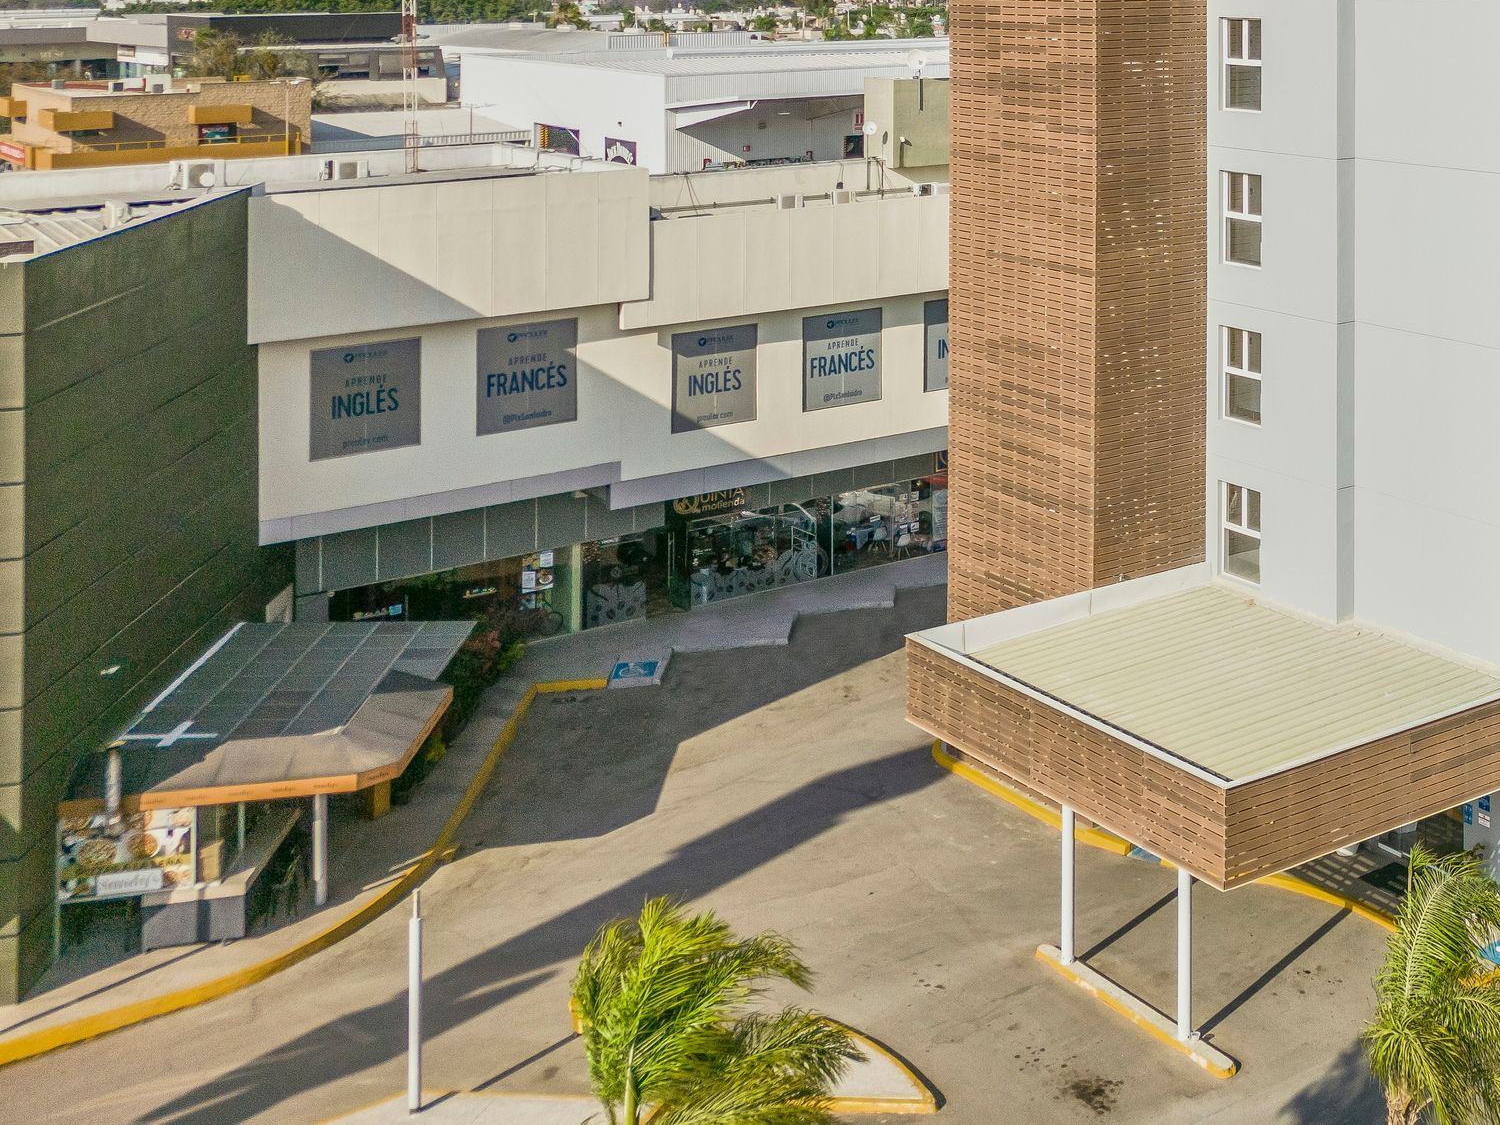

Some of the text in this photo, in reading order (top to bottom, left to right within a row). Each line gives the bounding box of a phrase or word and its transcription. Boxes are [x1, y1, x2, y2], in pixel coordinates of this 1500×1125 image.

[827, 338, 859, 350] APRENDE
[507, 353, 547, 366] APRENDE
[698, 357, 733, 369] APRENDE
[810, 345, 875, 378] FRANCÉS
[344, 374, 388, 388] APRENDE
[486, 360, 568, 398] FRANCÉS
[688, 365, 742, 397] INGLÉS
[331, 384, 400, 420] INGLÉS
[701, 496, 745, 512] molienda
